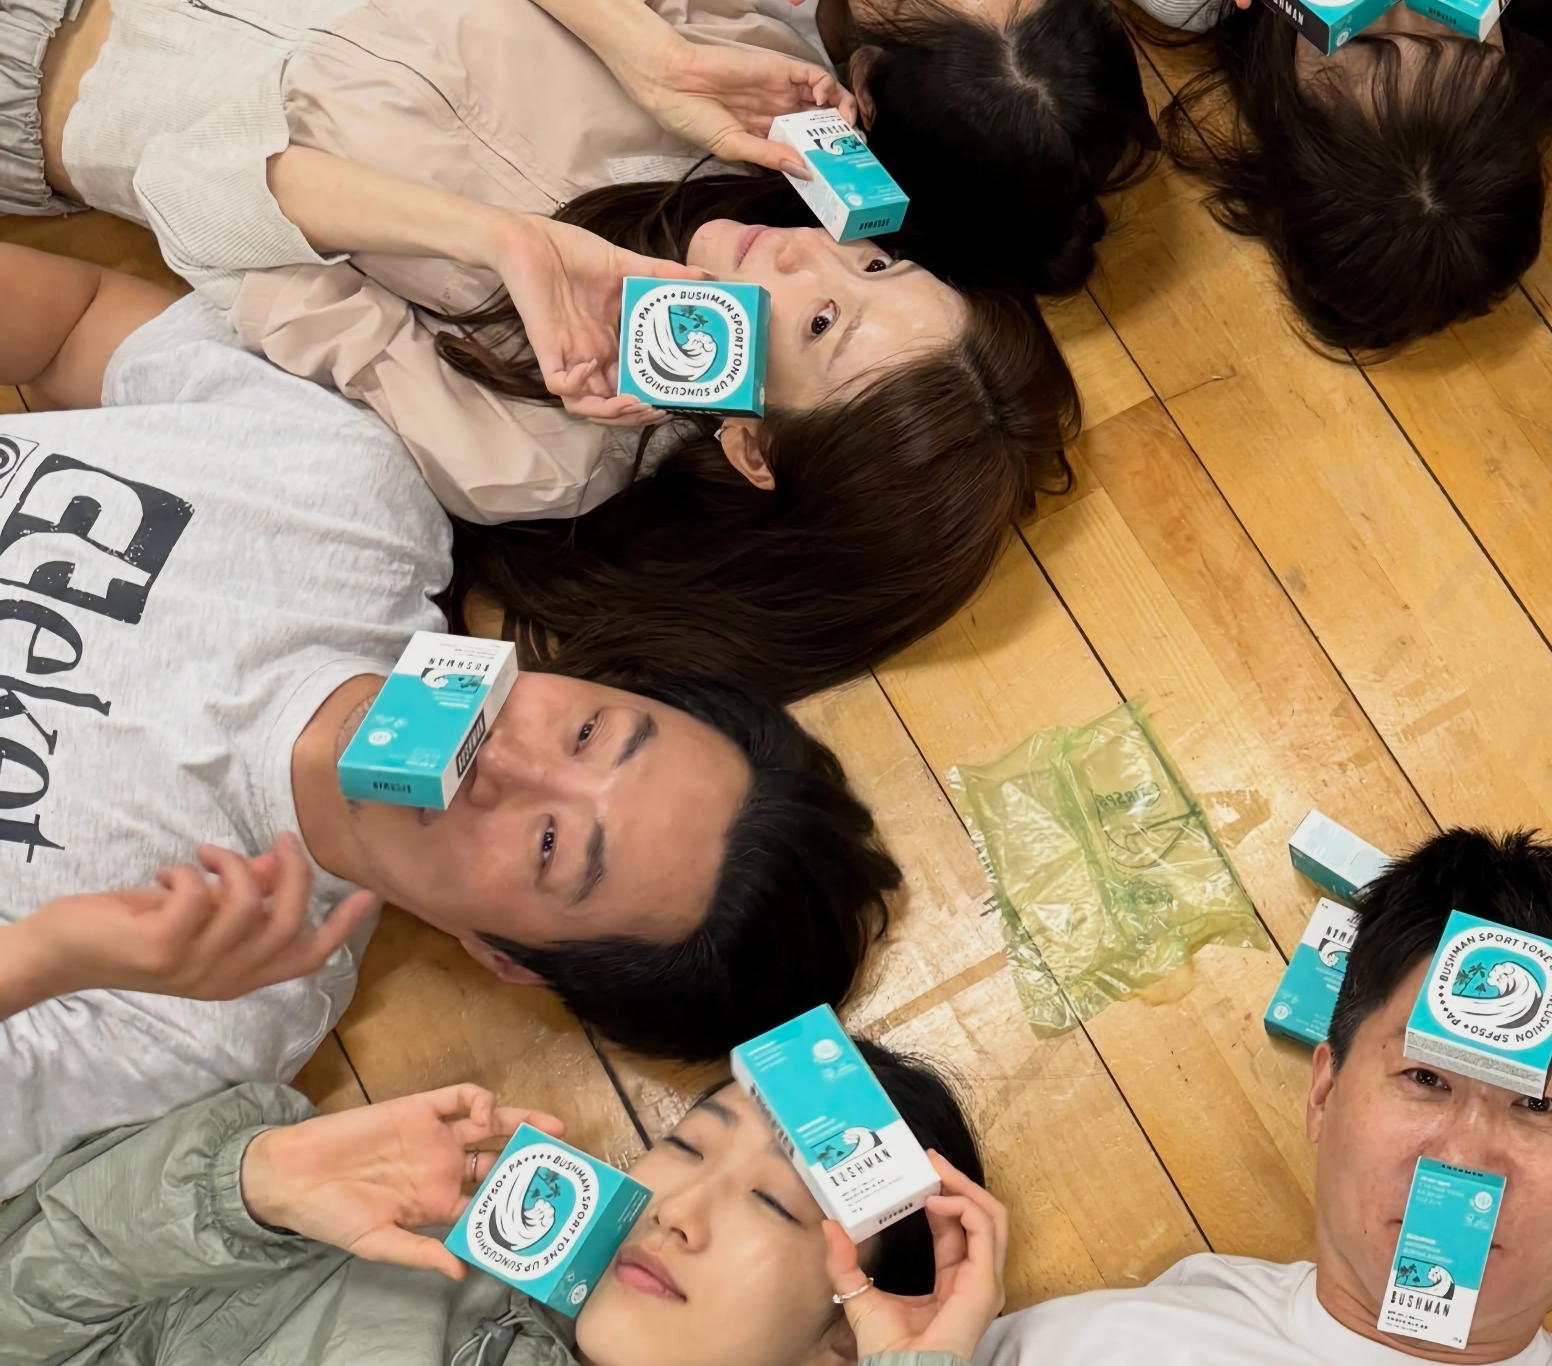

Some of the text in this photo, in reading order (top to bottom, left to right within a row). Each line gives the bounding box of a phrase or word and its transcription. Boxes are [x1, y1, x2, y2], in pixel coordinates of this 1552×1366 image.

[680, 290, 735, 313] BUSHMAN
[730, 312, 744, 351] SPORT
[638, 368, 710, 397] SUNCUSHION
[730, 353, 743, 383] TONE
[714, 380, 729, 394] UP
[428, 657, 490, 672] BUSHMAN
[1439, 935, 1476, 983] BUSHMAN
[1478, 932, 1520, 947] SPORT
[1522, 941, 1552, 963] TONE
[552, 1155, 591, 1193] BUSHMAN
[569, 1196, 591, 1236] SPORT
[475, 1221, 523, 1273] SUNCUSHION
[543, 1236, 570, 1267] TONE
[524, 1262, 540, 1273] UP
[1390, 1290, 1451, 1318] BUSHMAN
